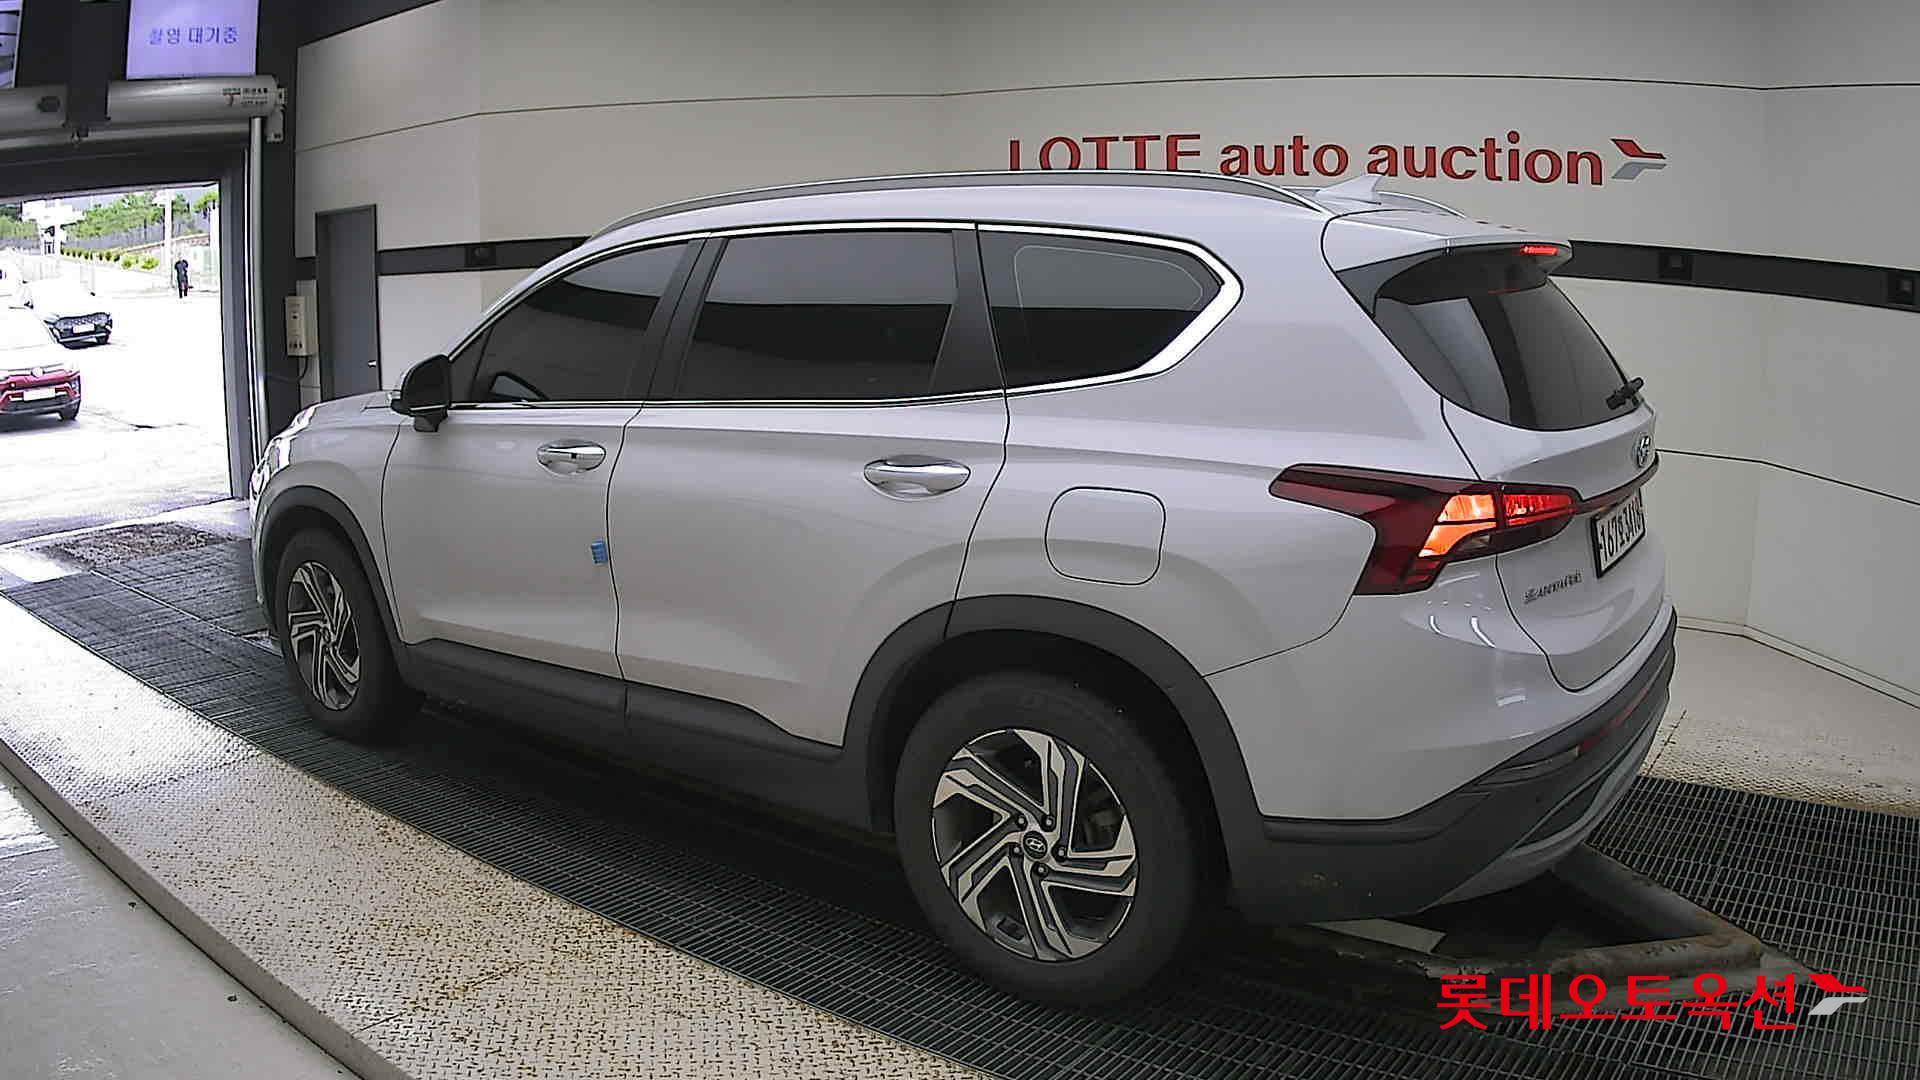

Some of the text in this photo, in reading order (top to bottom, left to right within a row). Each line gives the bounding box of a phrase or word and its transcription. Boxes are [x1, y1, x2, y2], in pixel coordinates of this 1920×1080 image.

[188, 26, 238, 45] 대기중
[1008, 131, 1604, 186] LOTTE auto auction
